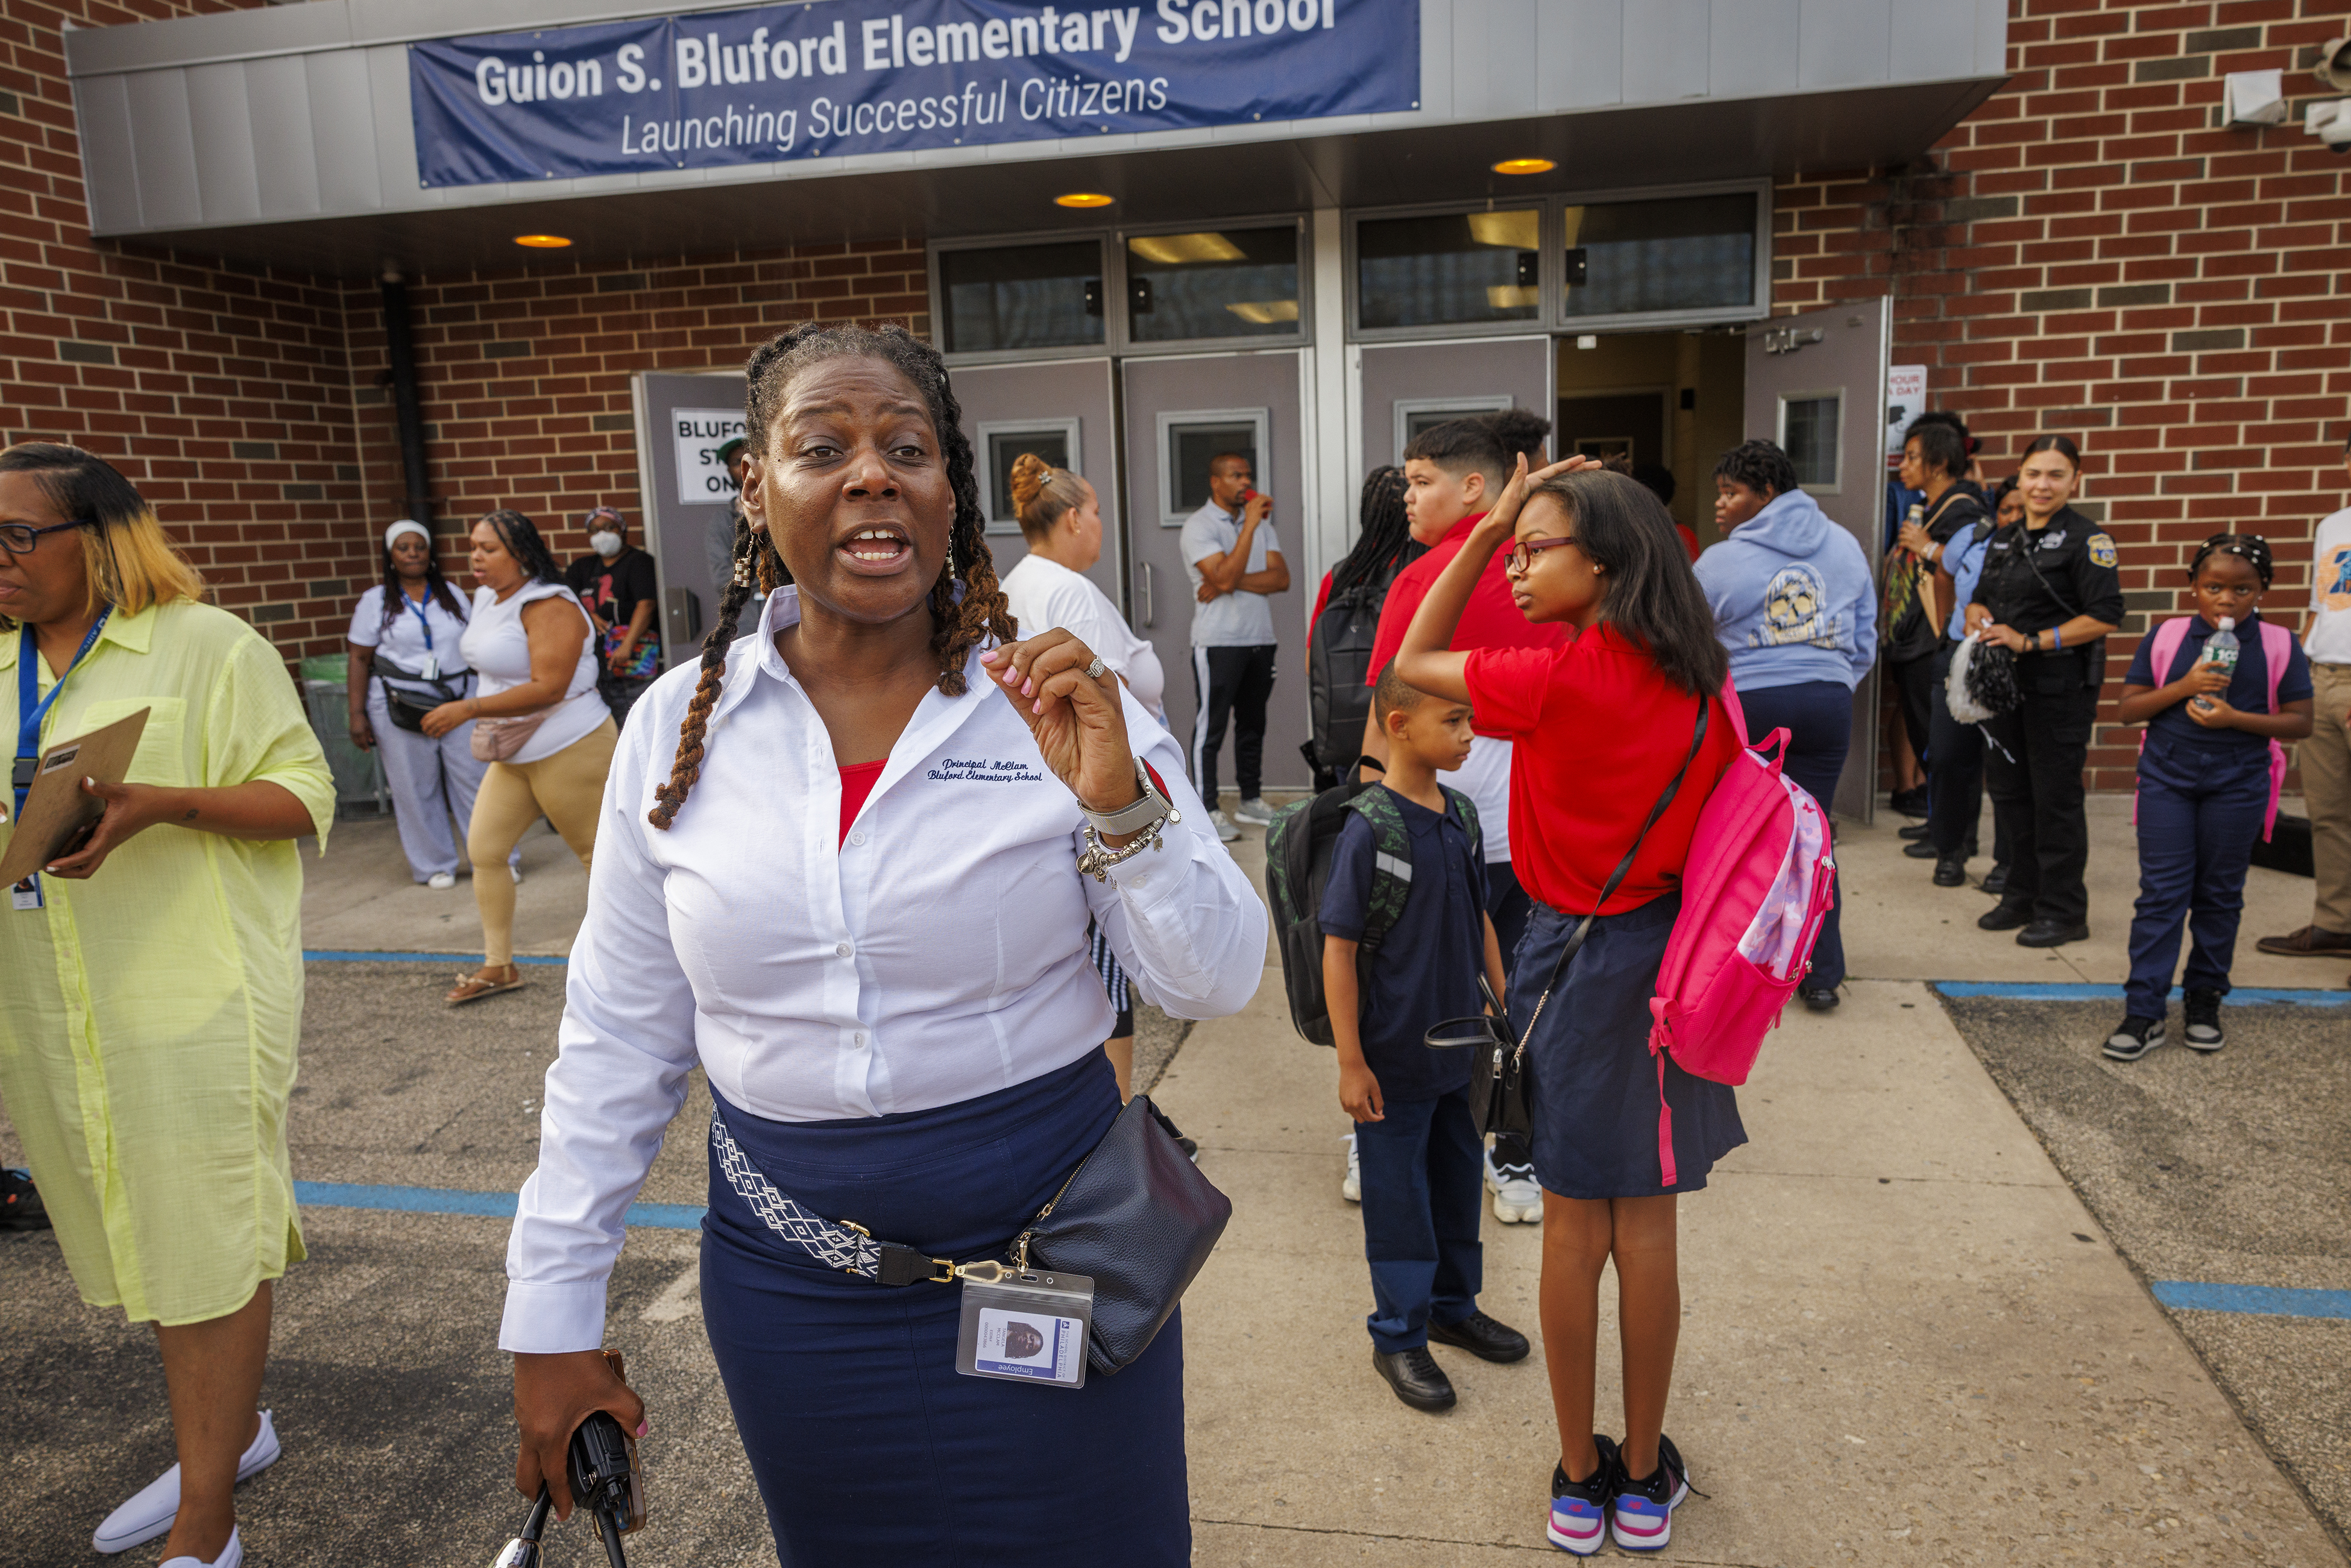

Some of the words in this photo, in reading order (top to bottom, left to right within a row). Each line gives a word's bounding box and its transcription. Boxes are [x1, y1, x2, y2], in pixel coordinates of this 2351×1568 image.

[475, 49, 603, 106] Guion
[615, 43, 662, 94] S.
[676, 21, 846, 89] Bluford
[862, 5, 1140, 71] Elementary
[1156, 0, 1335, 44] School
[622, 104, 798, 155] Launching
[808, 78, 1007, 139] Successful
[1019, 74, 1168, 121] Citizens
[927, 770, 964, 782] Bluford
[966, 770, 1013, 782] Elementary
[1015, 772, 1043, 782] School
[942, 758, 987, 770] Principal
[1057, 1330, 1066, 1378] PHILADELPHIA
[998, 1364, 1033, 1375] Employee
